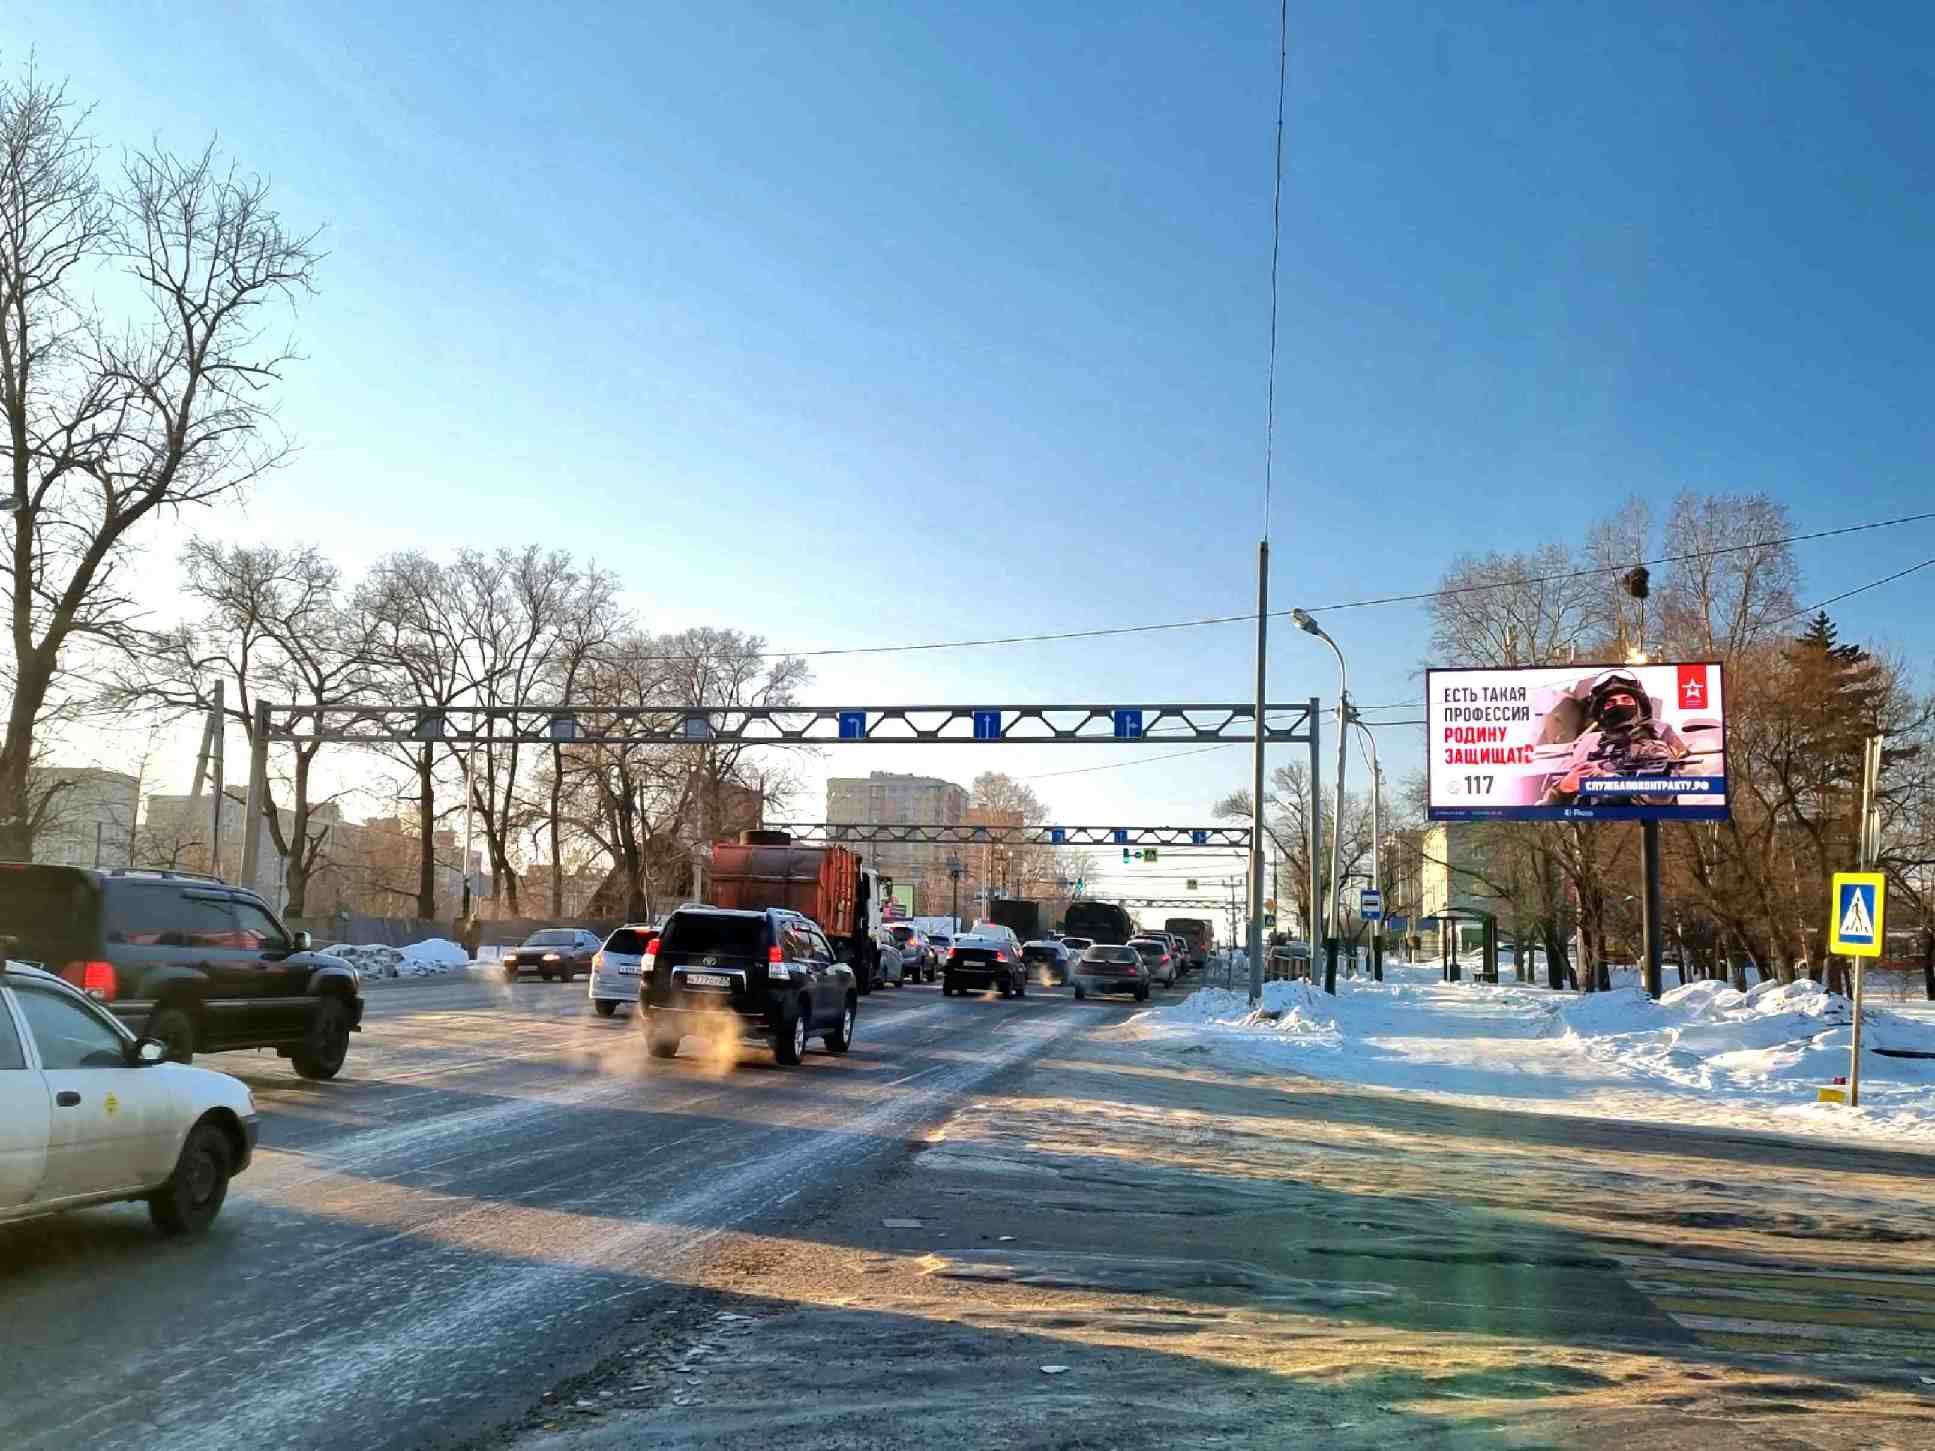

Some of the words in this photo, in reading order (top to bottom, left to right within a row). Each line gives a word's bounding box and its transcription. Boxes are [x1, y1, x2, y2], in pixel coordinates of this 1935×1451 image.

[1444, 687, 1478, 703] ЕСТЬ
[1482, 687, 1527, 702] ТАКАЯ
[1444, 706, 1530, 722] ПРОФЕССИЯ
[1444, 726, 1508, 744] РОДИНУ
[1464, 775, 1494, 795] 117
